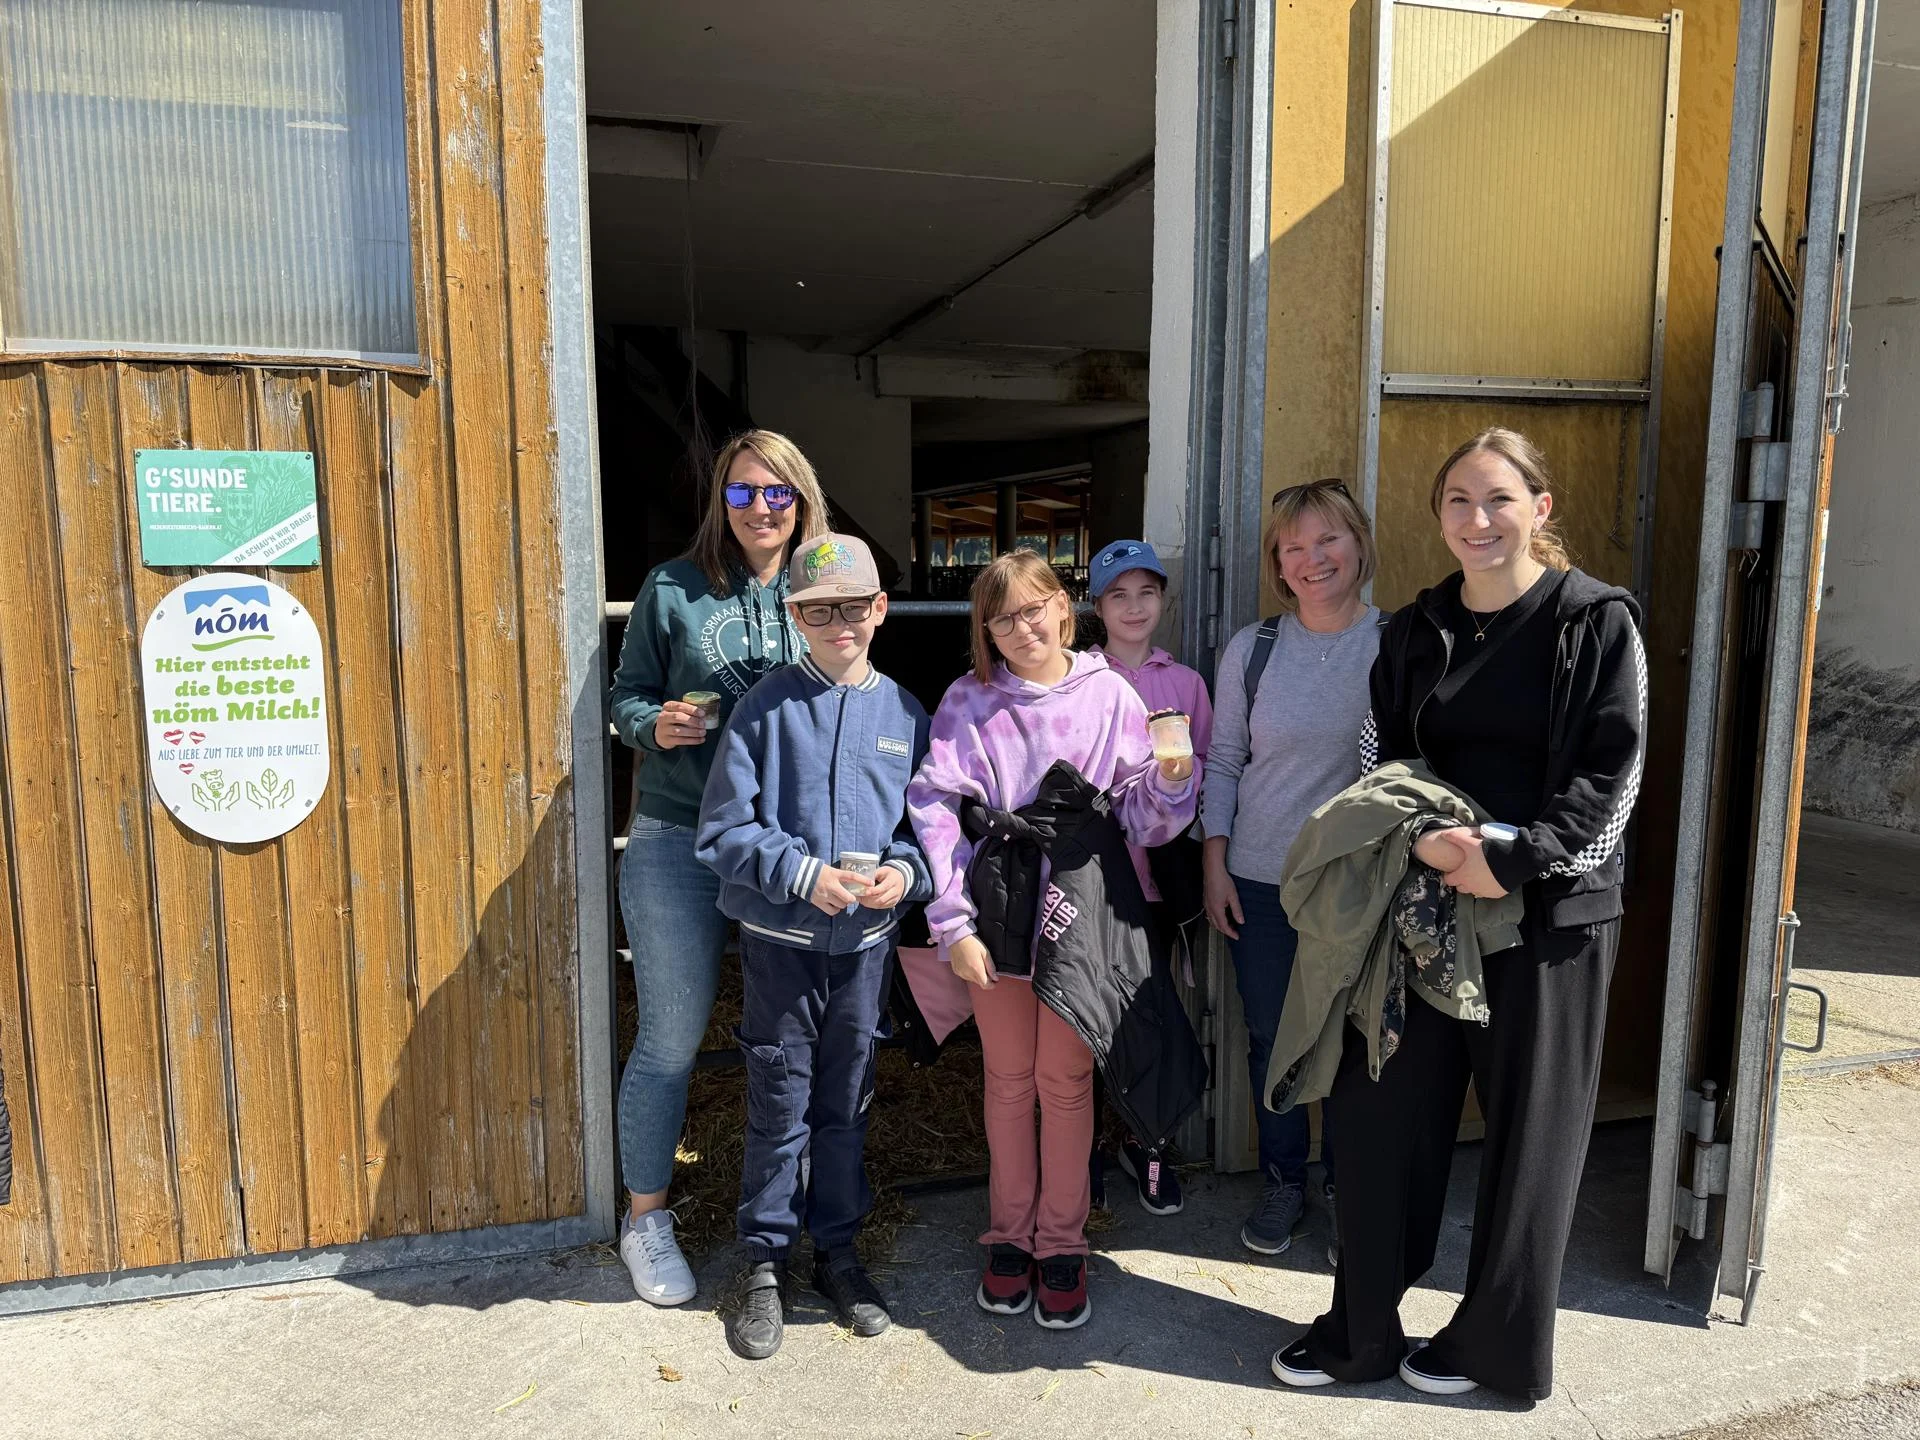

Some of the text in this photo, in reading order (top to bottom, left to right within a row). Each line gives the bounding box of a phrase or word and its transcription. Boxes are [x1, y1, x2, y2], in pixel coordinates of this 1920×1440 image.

[146, 492, 222, 514] TIERE.
[234, 554, 246, 563] DA
[245, 535, 277, 557] SCHAU'N
[275, 526, 291, 538] WIR
[289, 512, 316, 530] DRAUF.
[263, 533, 298, 558] DU AUCH?
[155, 654, 310, 673] Hier entsteht
[174, 675, 295, 697] die beste
[152, 697, 320, 724] nöm Milch!
[158, 744, 321, 761] AUS LIEBE ZUM TIER UND DER UMWELT.
[1043, 901, 1079, 942] CLUB
